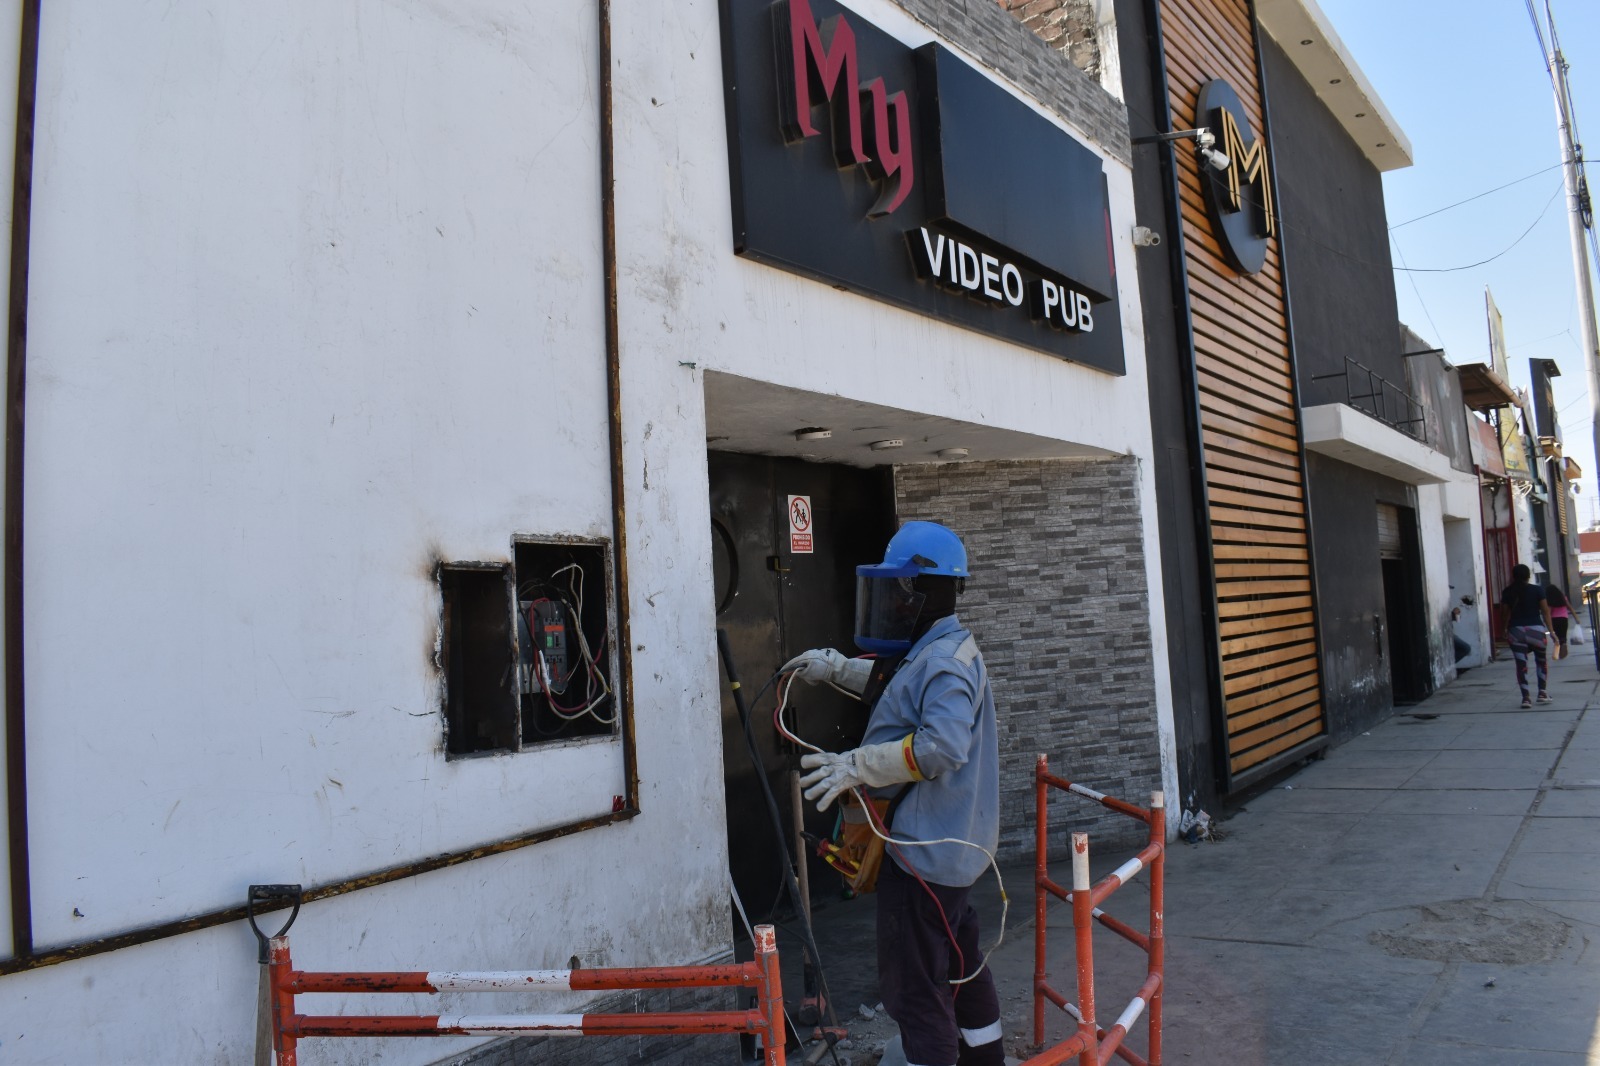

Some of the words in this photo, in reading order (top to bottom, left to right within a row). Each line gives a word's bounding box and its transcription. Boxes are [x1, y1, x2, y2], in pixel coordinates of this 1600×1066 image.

[788, 0, 914, 215] My
[1220, 106, 1275, 237] M
[920, 227, 1024, 306] VIDEO
[1041, 279, 1094, 333] PUB
